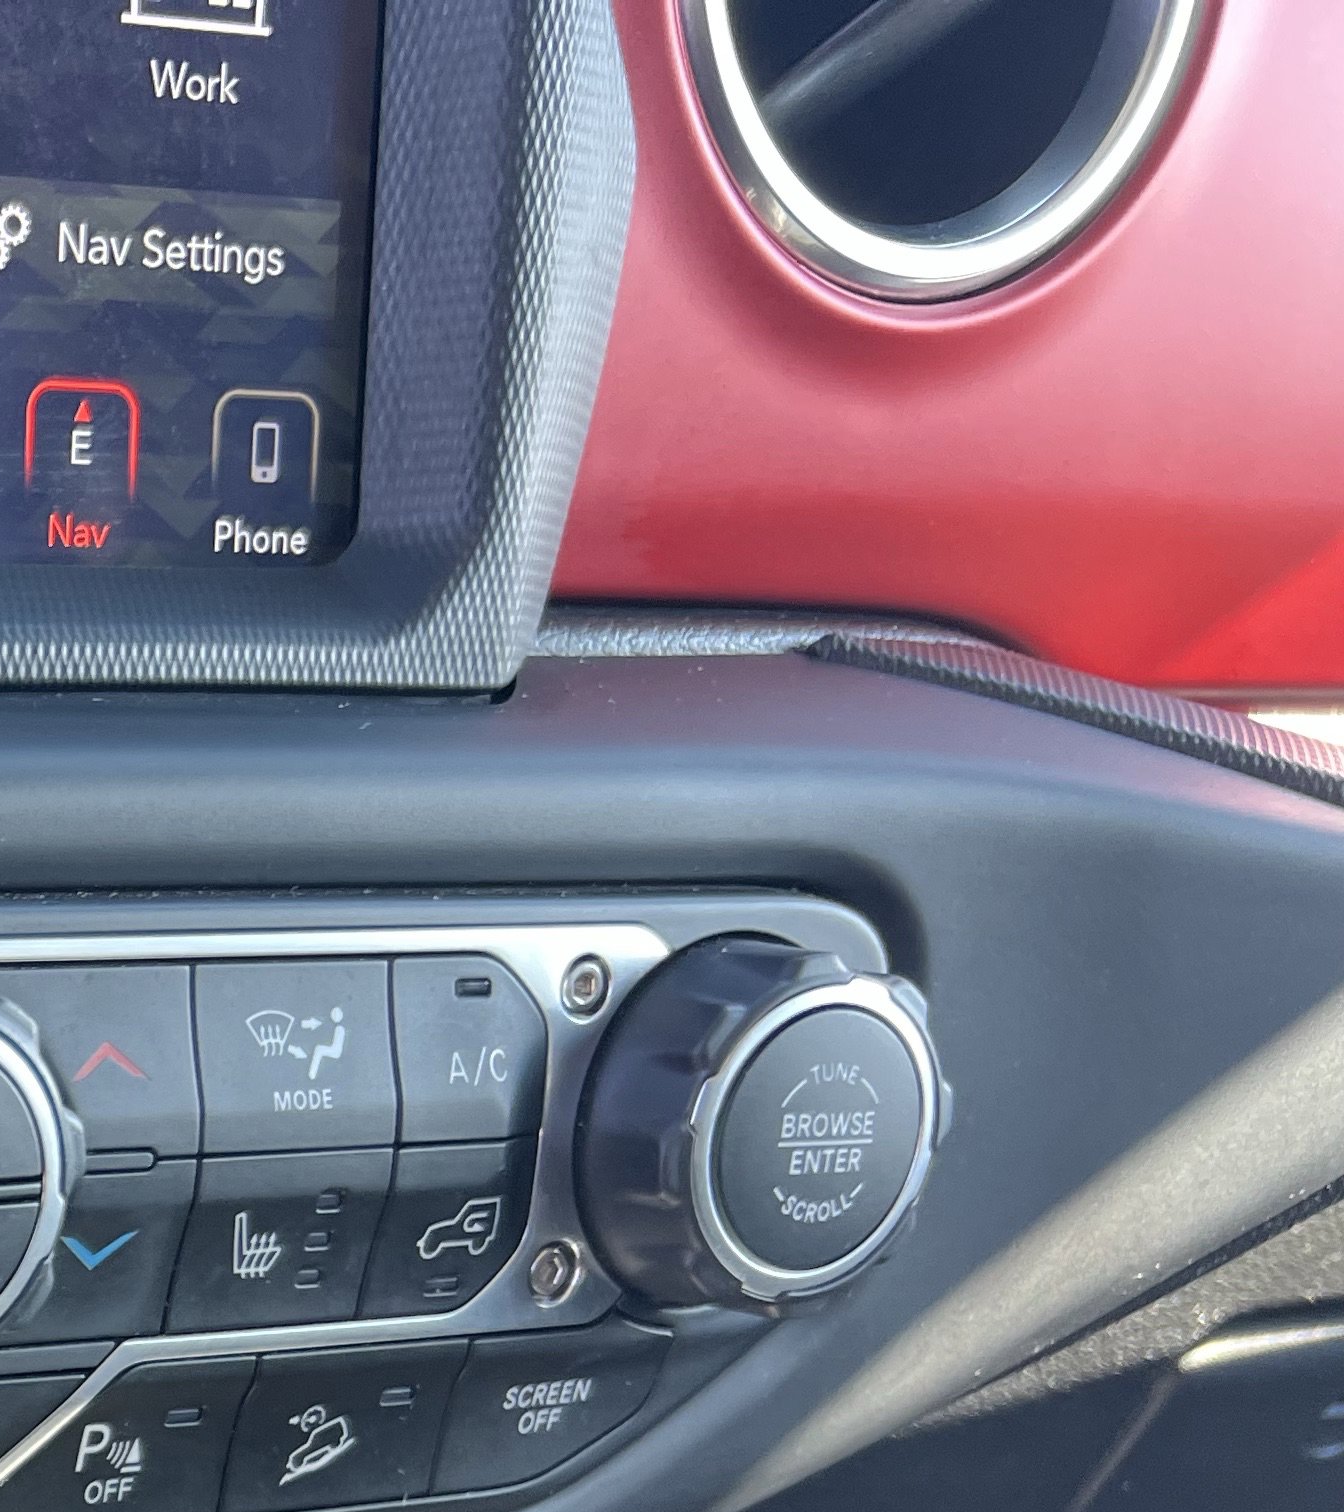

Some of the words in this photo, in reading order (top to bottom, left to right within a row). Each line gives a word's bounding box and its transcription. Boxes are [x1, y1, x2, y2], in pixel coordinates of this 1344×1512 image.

[150, 58, 240, 105] Work
[58, 223, 132, 266] Nav
[142, 227, 285, 285] Settings
[48, 511, 111, 549] Nav
[214, 518, 308, 555] Phone
[449, 1046, 508, 1086] A/C
[809, 1062, 860, 1086] TUNE
[273, 1088, 333, 1112] MODE
[780, 1110, 876, 1138] BROWSE
[789, 1147, 863, 1175] ENTER
[780, 1194, 853, 1224] SCROLL
[502, 1378, 592, 1412] SCREEN
[517, 1406, 563, 1435] OFF
[84, 1476, 135, 1505] OFF
